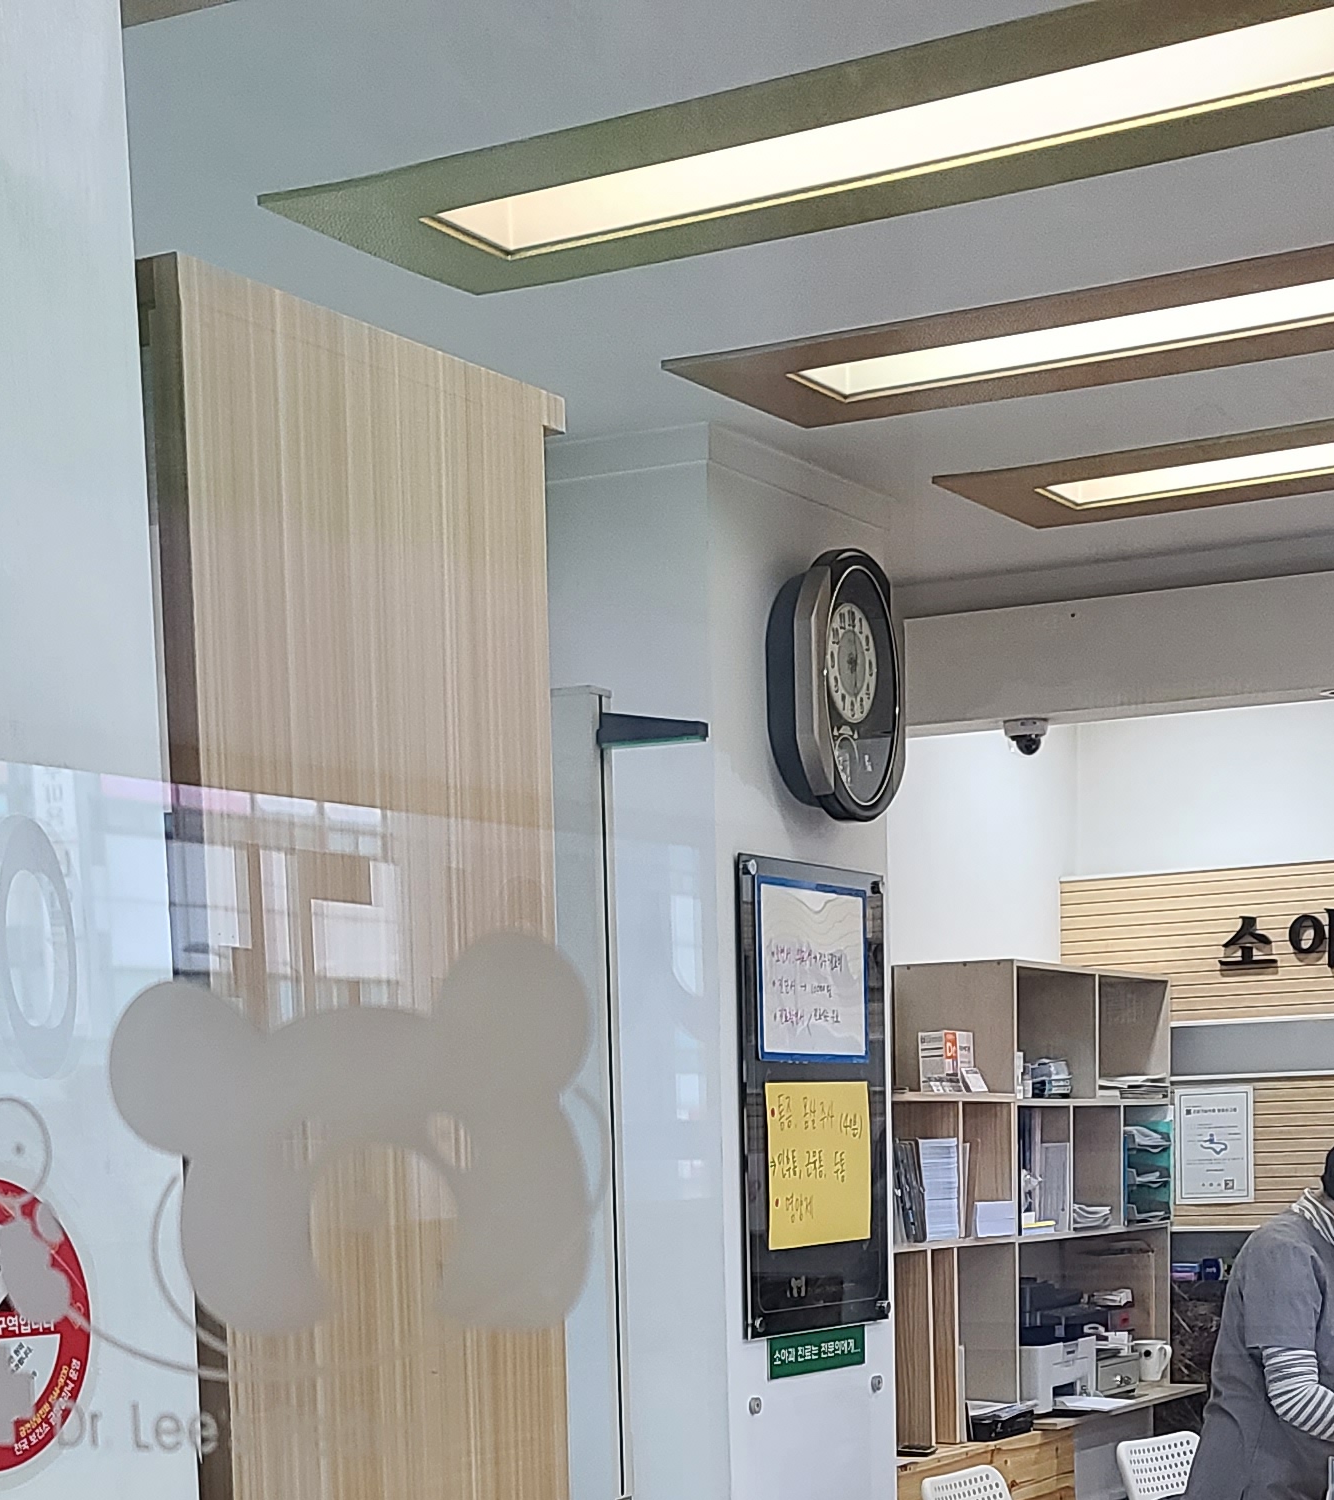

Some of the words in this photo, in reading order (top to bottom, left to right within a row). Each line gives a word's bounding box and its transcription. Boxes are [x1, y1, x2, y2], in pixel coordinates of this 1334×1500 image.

[773, 1347, 796, 1365] 소아과
[797, 1345, 819, 1362] 진료는
[128, 1400, 220, 1455] Lee
